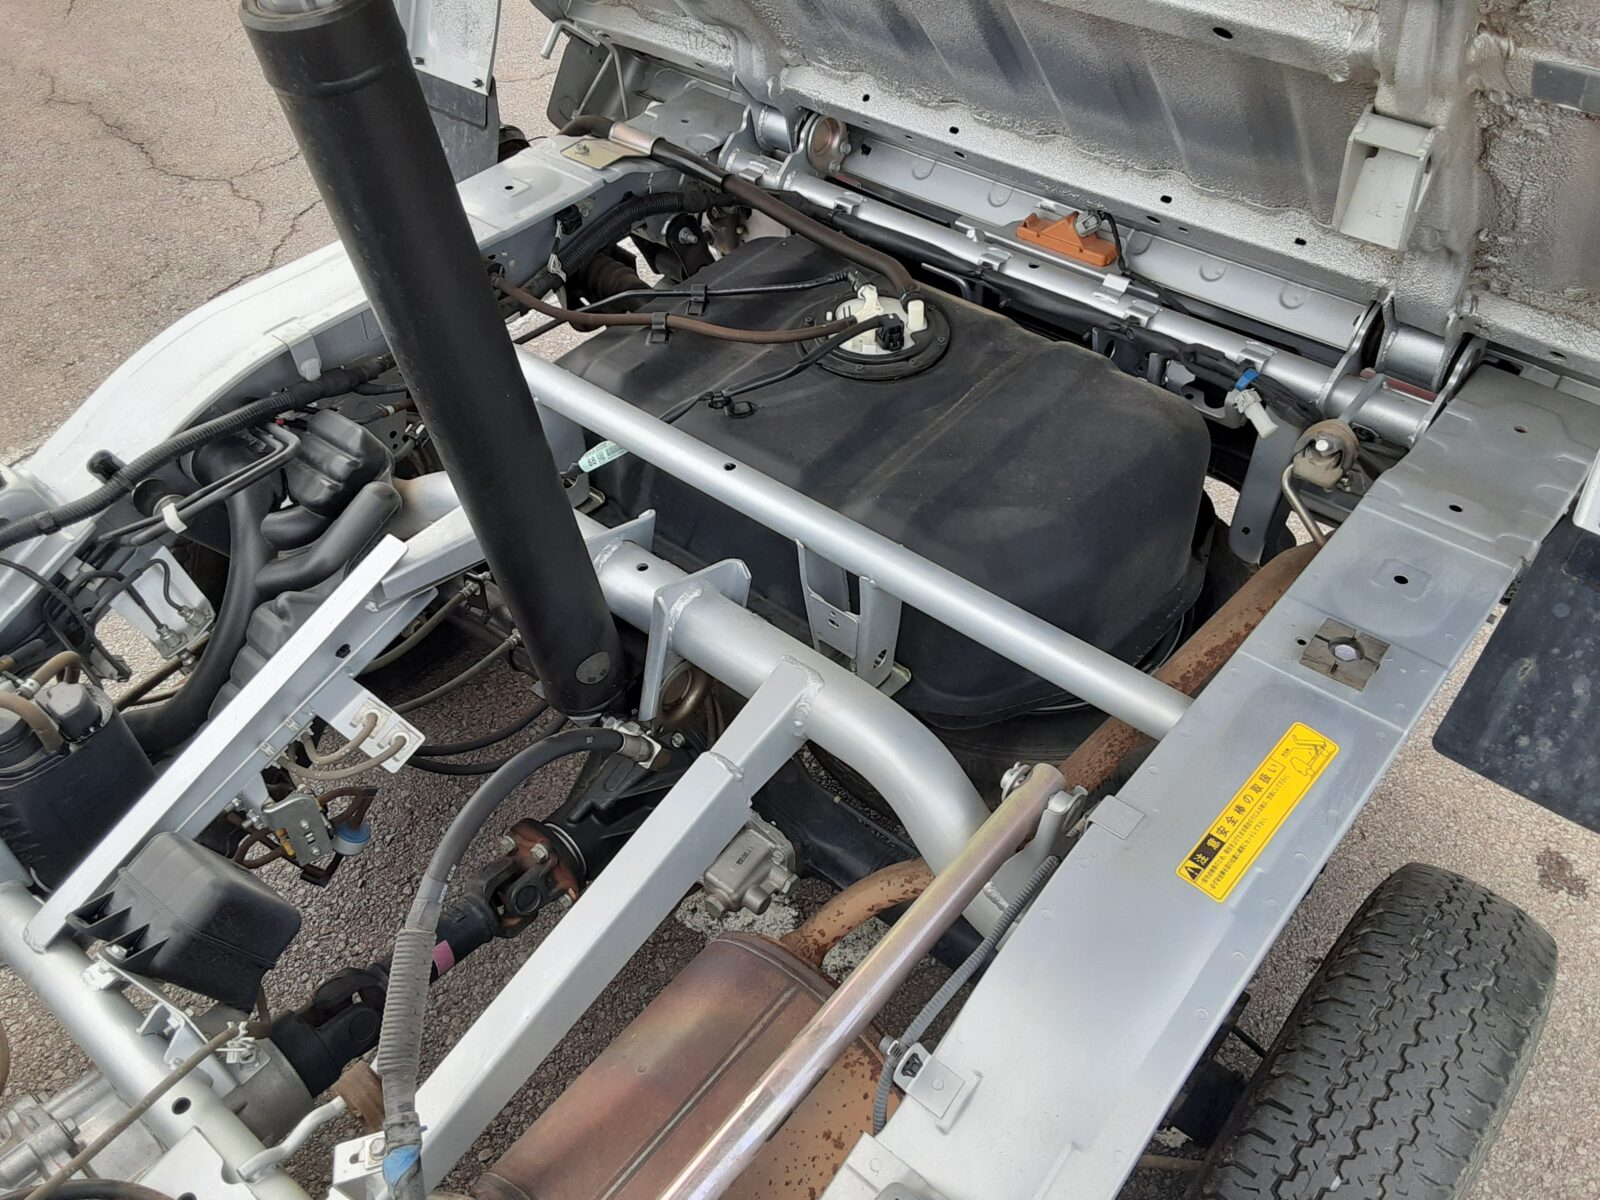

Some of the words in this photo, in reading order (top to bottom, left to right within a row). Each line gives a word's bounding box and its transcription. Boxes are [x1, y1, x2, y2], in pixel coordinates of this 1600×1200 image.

[1194, 838, 1221, 866] 注意
[1216, 763, 1278, 837] 安全棒の取扱い
